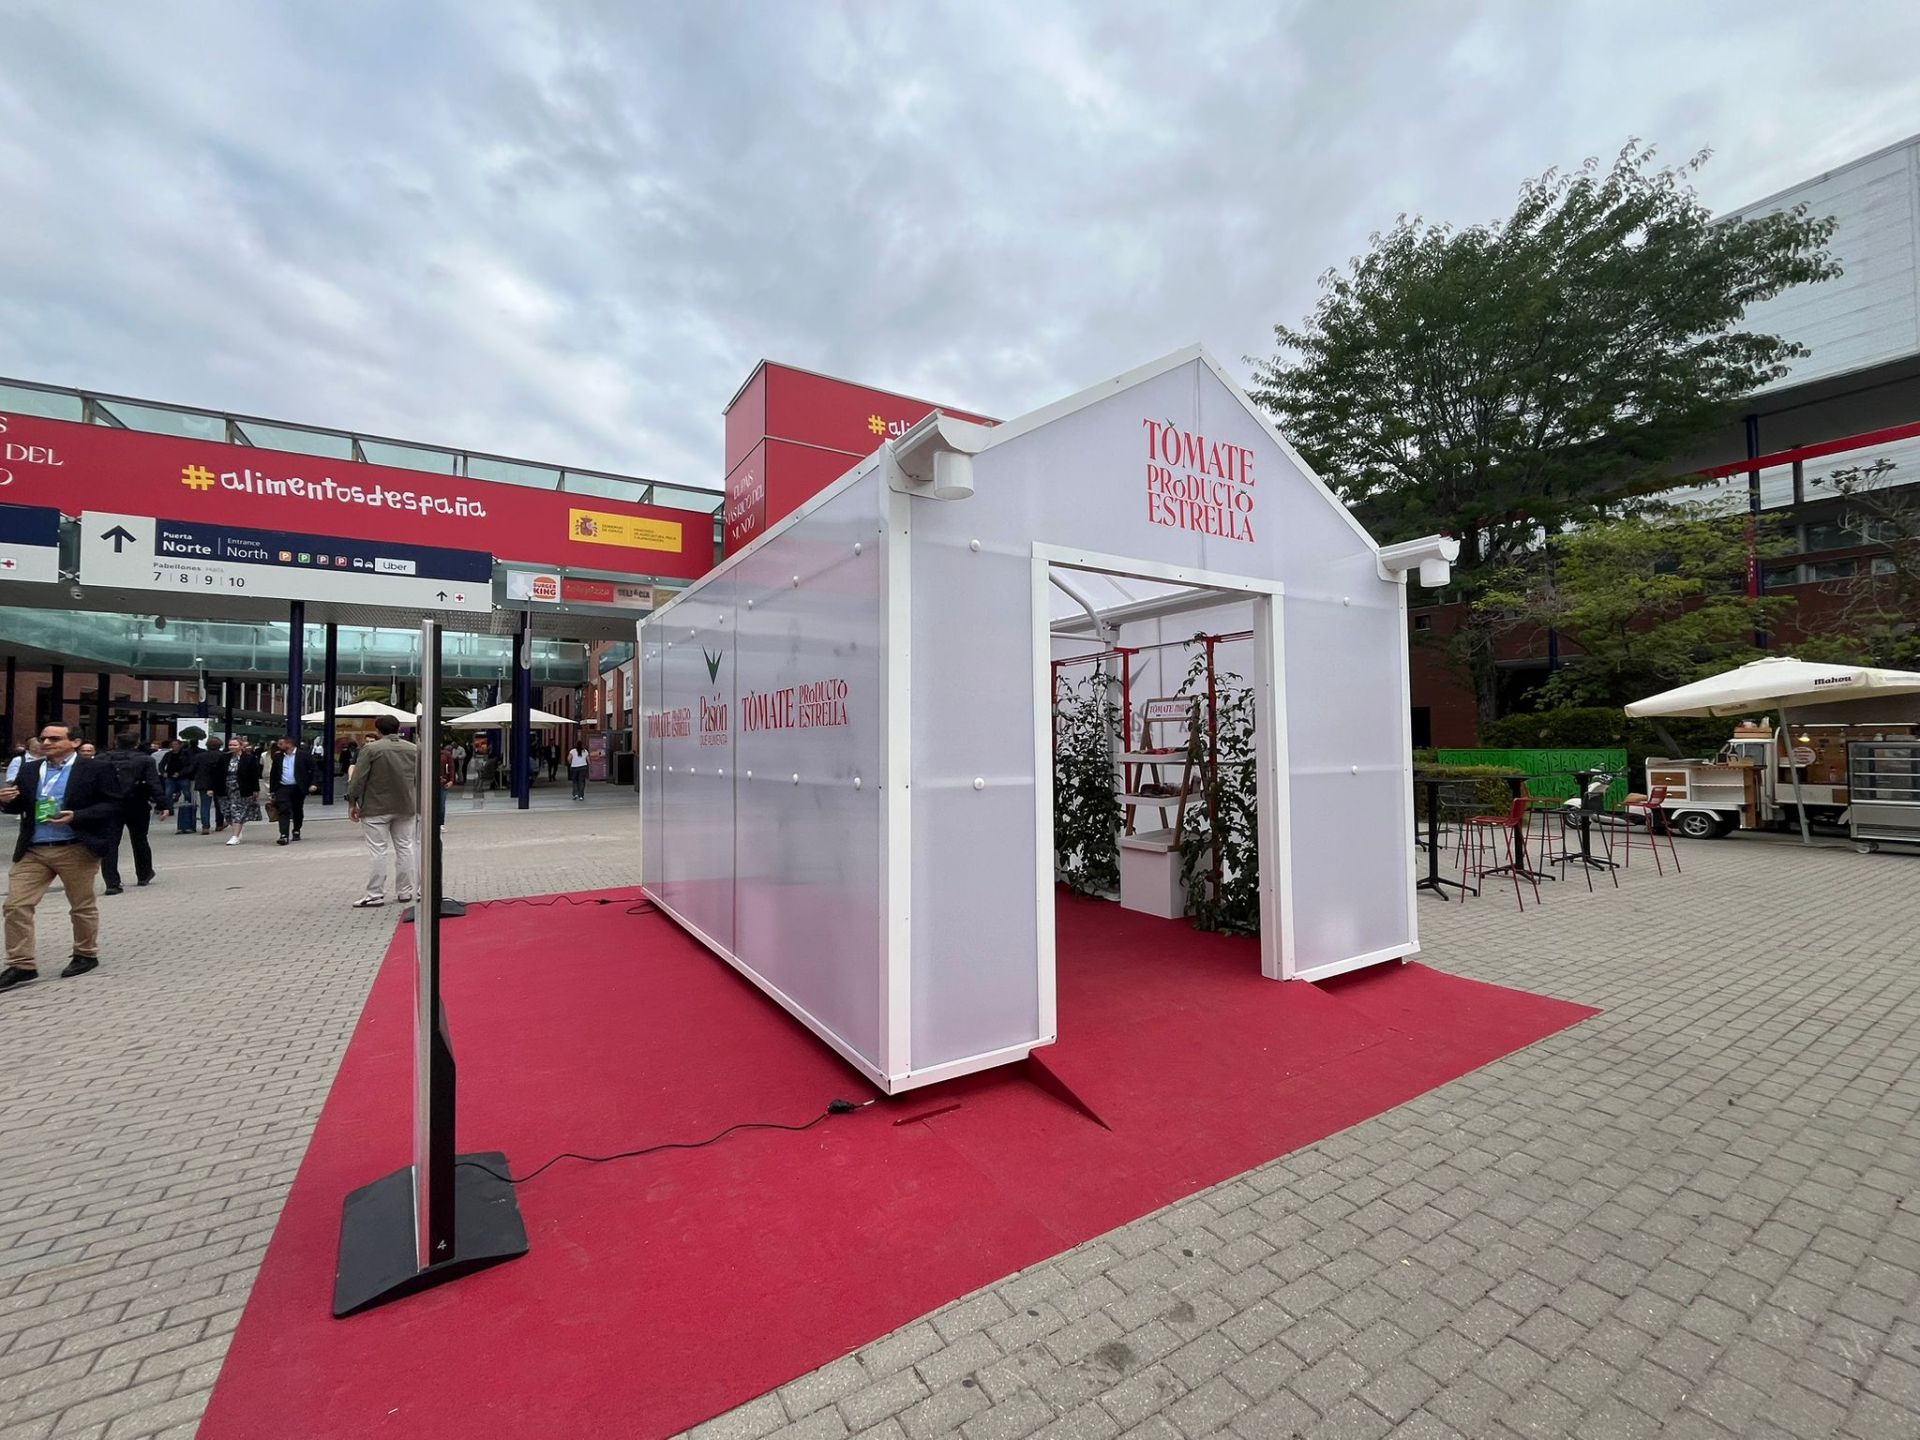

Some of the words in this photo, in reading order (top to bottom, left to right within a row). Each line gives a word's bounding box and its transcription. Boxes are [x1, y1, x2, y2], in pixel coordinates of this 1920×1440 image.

[6, 443, 64, 466] DEL
[1143, 418, 1255, 487] TOMATE
[181, 464, 487, 518] #alimentosdespaña
[1148, 491, 1255, 542] ESTRELLA
[163, 531, 192, 540] Puerta
[227, 537, 261, 547] Entrance
[163, 540, 212, 555] Norte
[227, 546, 268, 560] North
[153, 562, 201, 571] Pabellones
[383, 562, 408, 572] Uber
[153, 571, 162, 581] 7
[180, 573, 189, 583] 8
[205, 575, 213, 585] 9
[229, 577, 245, 588] 10
[533, 587, 556, 596] KING
[1814, 676, 1852, 685] Mahou
[700, 692, 728, 732] Pasión
[741, 690, 795, 731] TOMATE
[799, 700, 848, 728] ESTRELLA
